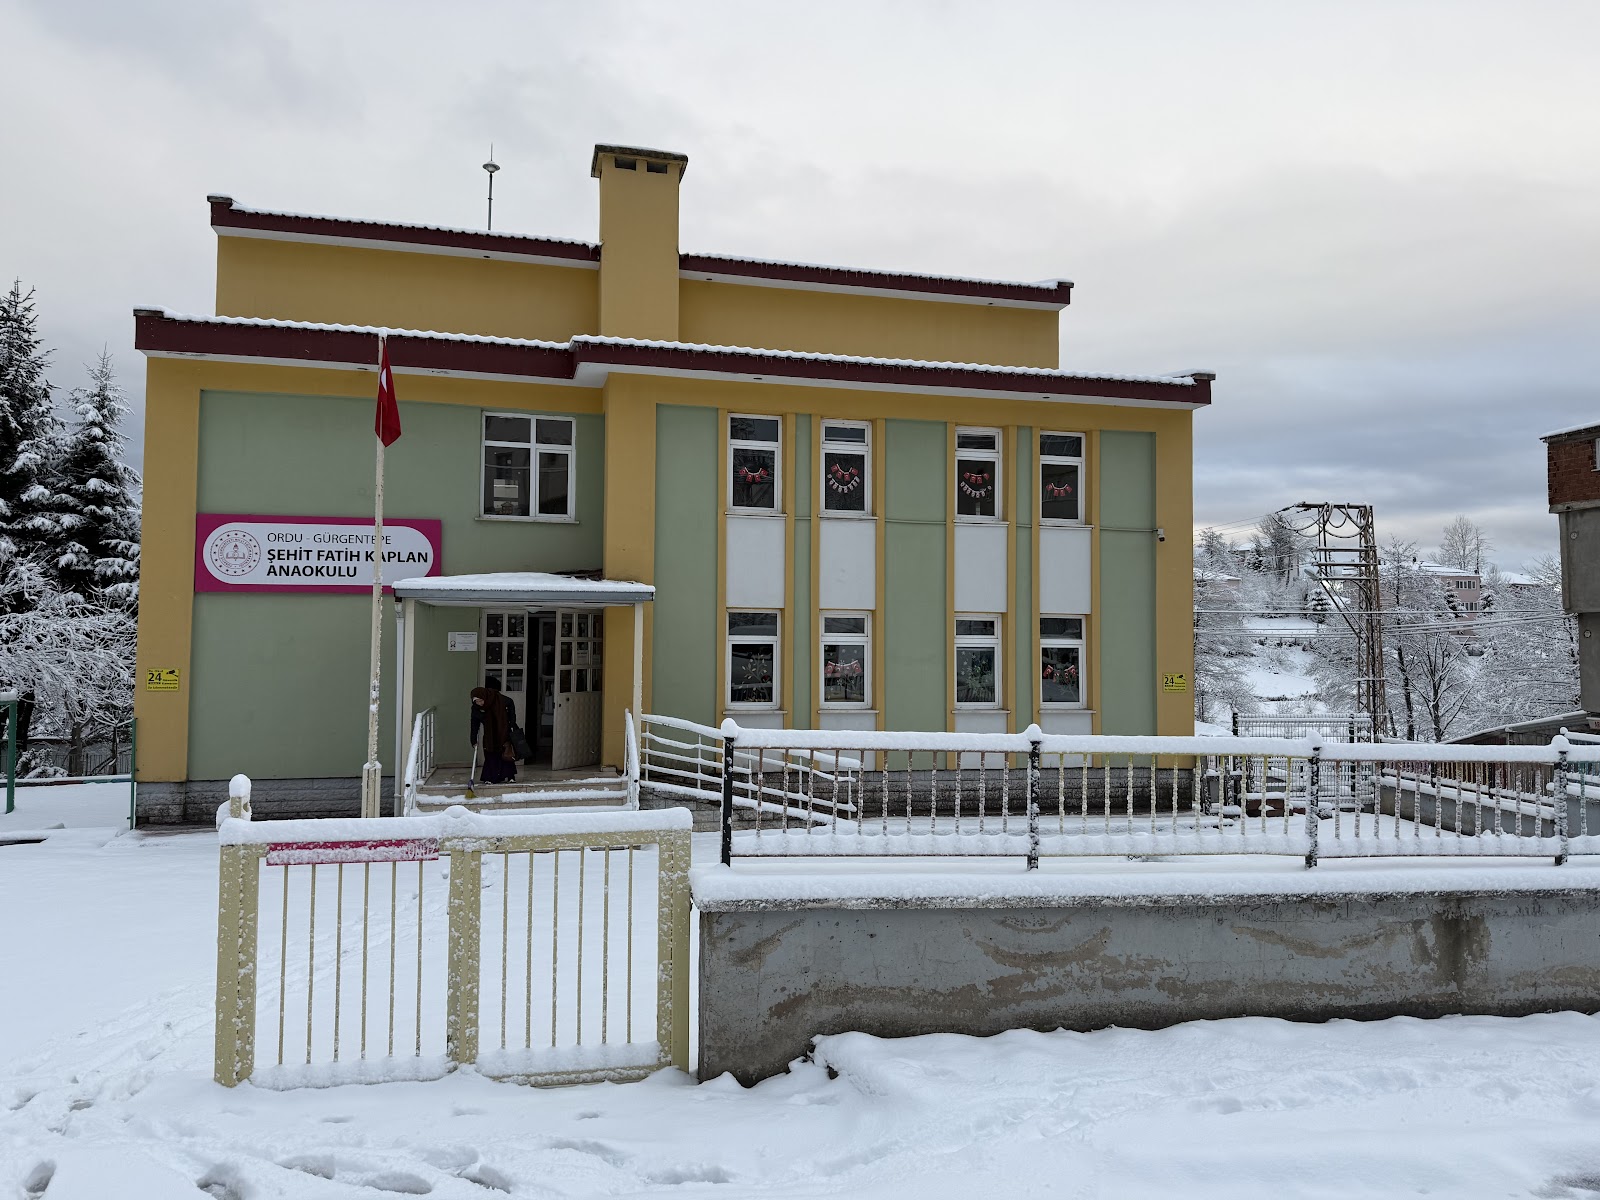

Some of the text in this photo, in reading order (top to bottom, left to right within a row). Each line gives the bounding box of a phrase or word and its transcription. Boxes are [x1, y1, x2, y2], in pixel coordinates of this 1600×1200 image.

[267, 532, 303, 543] ORDU
[267, 546, 313, 564] ŞEHİT
[317, 547, 360, 562] FATİH
[266, 564, 357, 577] ANAOKULU
[148, 672, 162, 681] 24
[1164, 676, 1174, 684] 24
